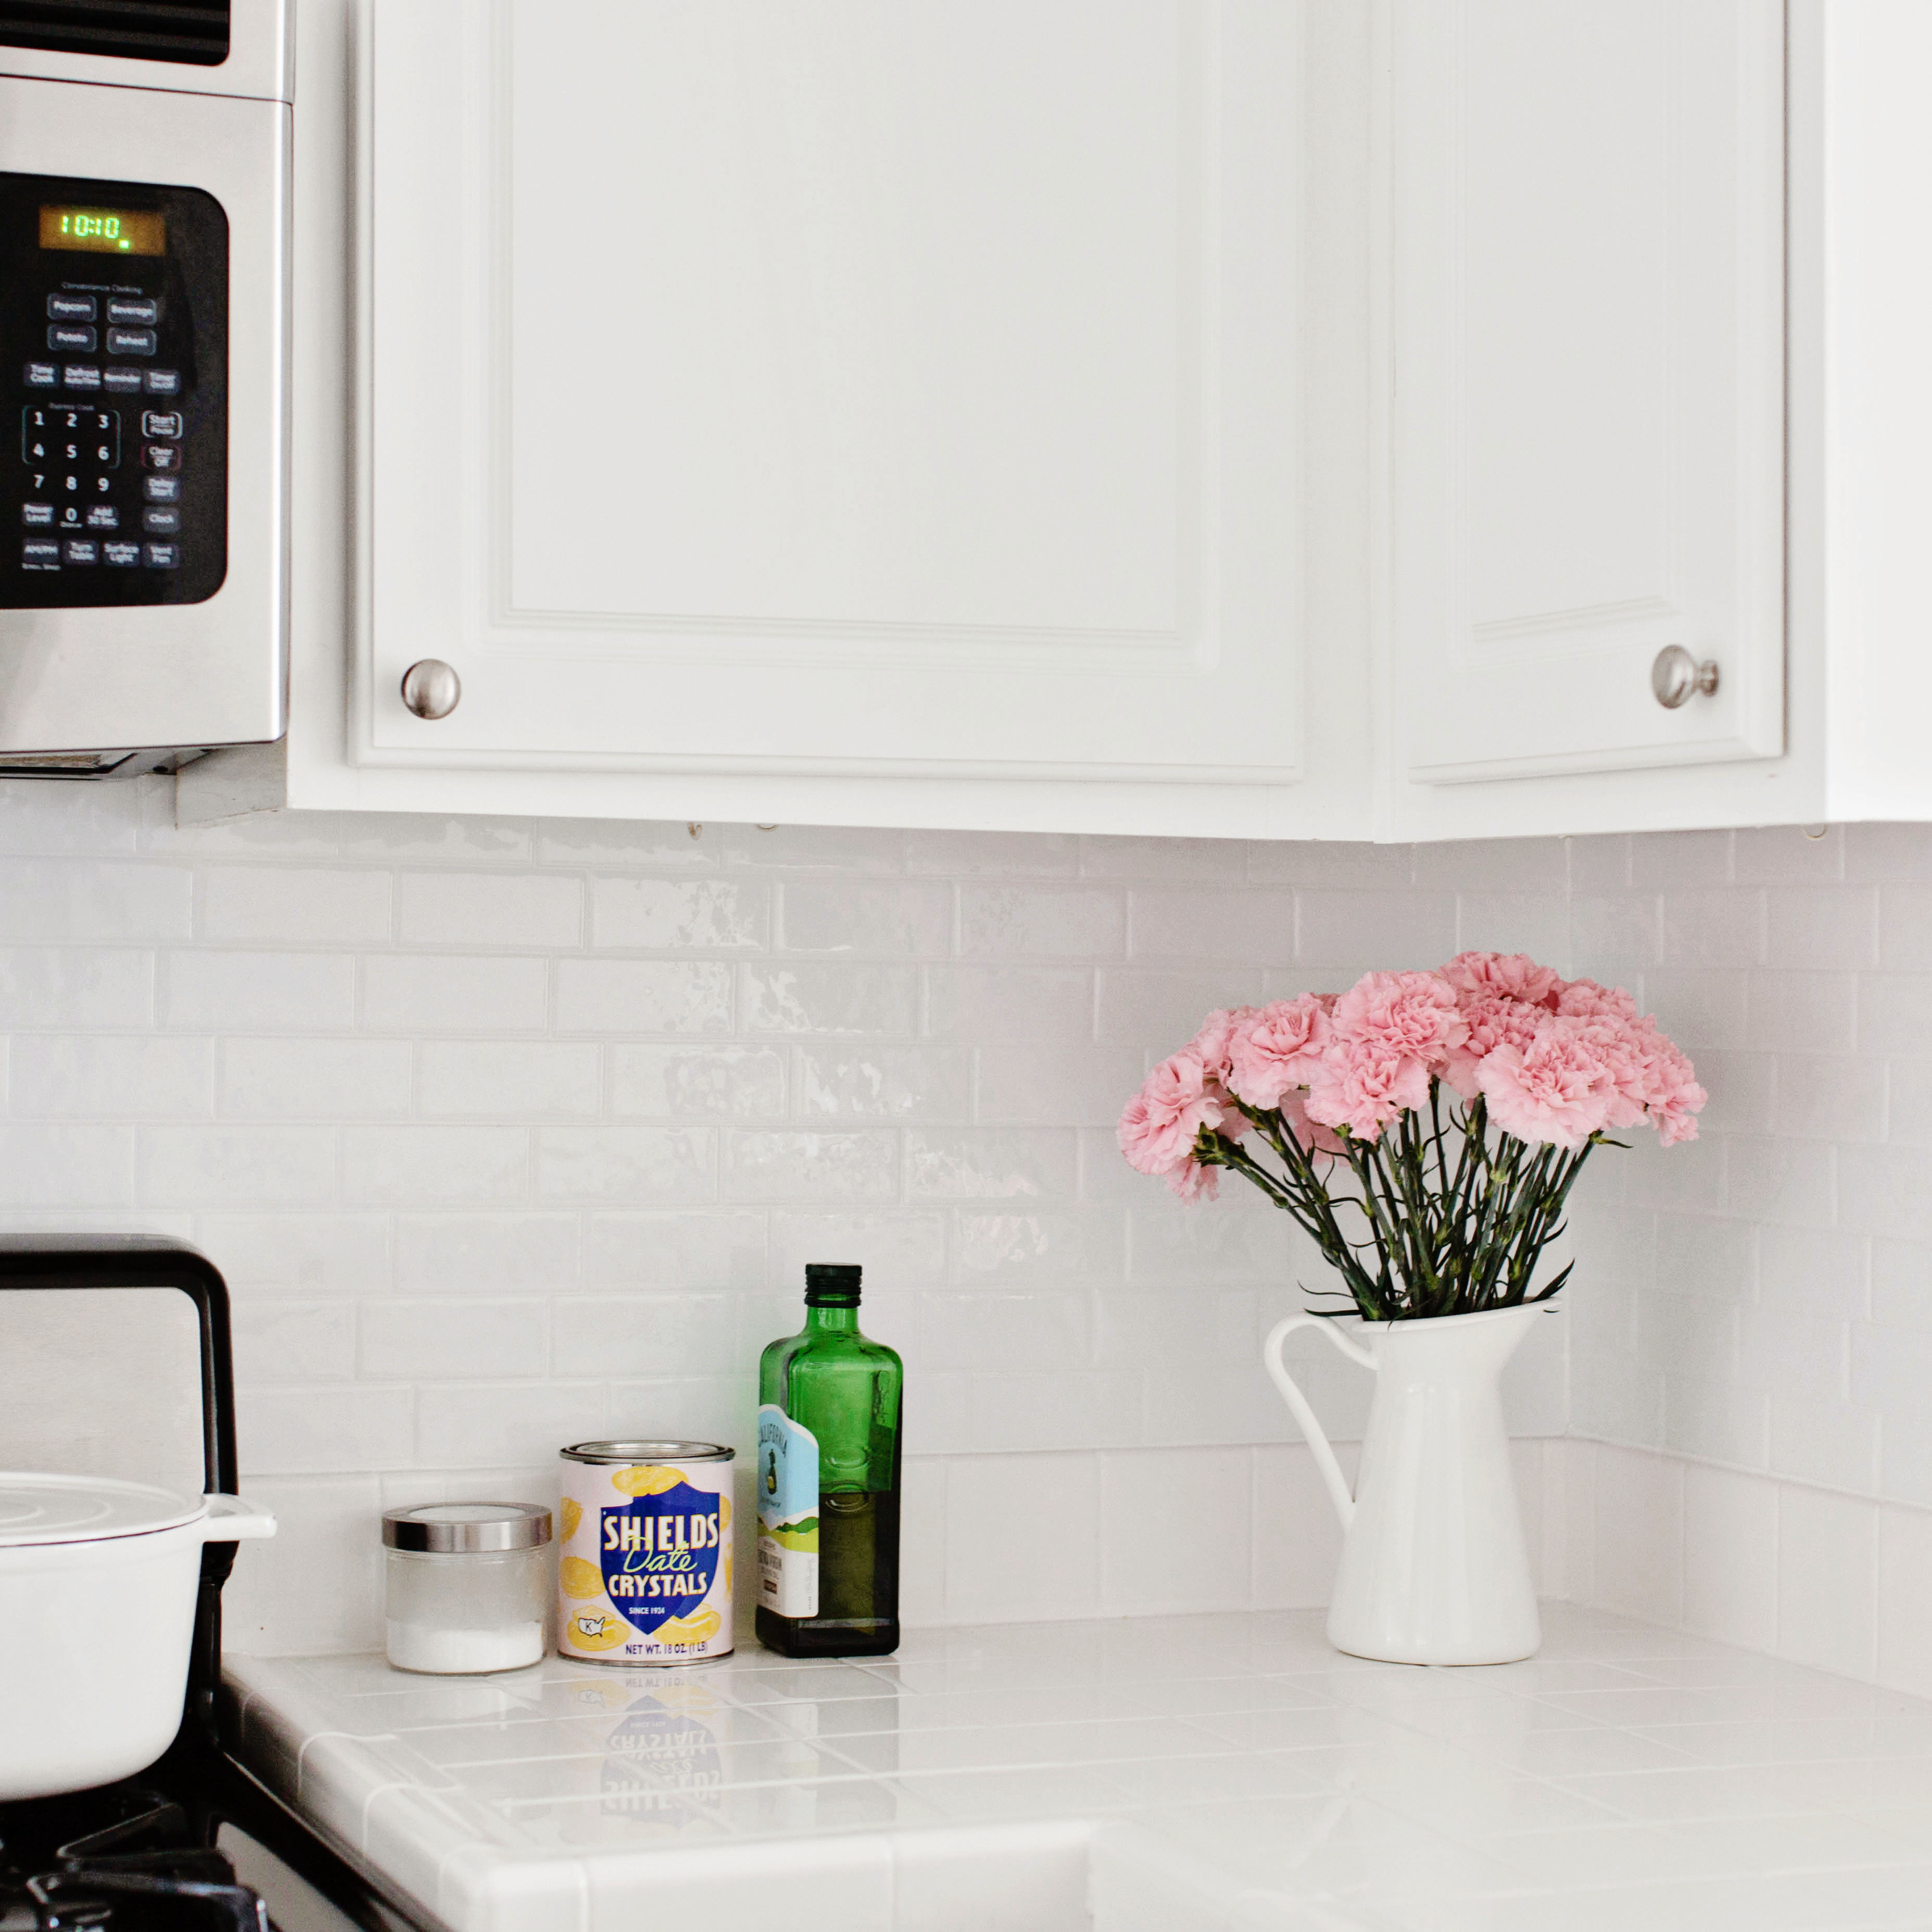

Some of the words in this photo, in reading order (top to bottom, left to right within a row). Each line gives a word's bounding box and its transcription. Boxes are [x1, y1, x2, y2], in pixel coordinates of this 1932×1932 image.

[62, 215, 120, 238] 10:10
[34, 412, 45, 426] 1
[67, 413, 77, 427] 2
[98, 414, 109, 428] 3
[33, 443, 45, 457] 4
[67, 445, 77, 459] 5
[98, 446, 109, 460] 6
[34, 474, 44, 488] 7
[66, 476, 77, 490] 8
[98, 477, 109, 491] 9
[66, 508, 77, 522] 0
[603, 1513, 718, 1551] SHIELDS
[623, 1536, 698, 1573] Date
[609, 1572, 708, 1597] CRYSTALS
[586, 1622, 592, 1632] K
[626, 1644, 642, 1655] NET
[646, 1644, 662, 1655] WT.
[674, 1643, 687, 1653] OZ
